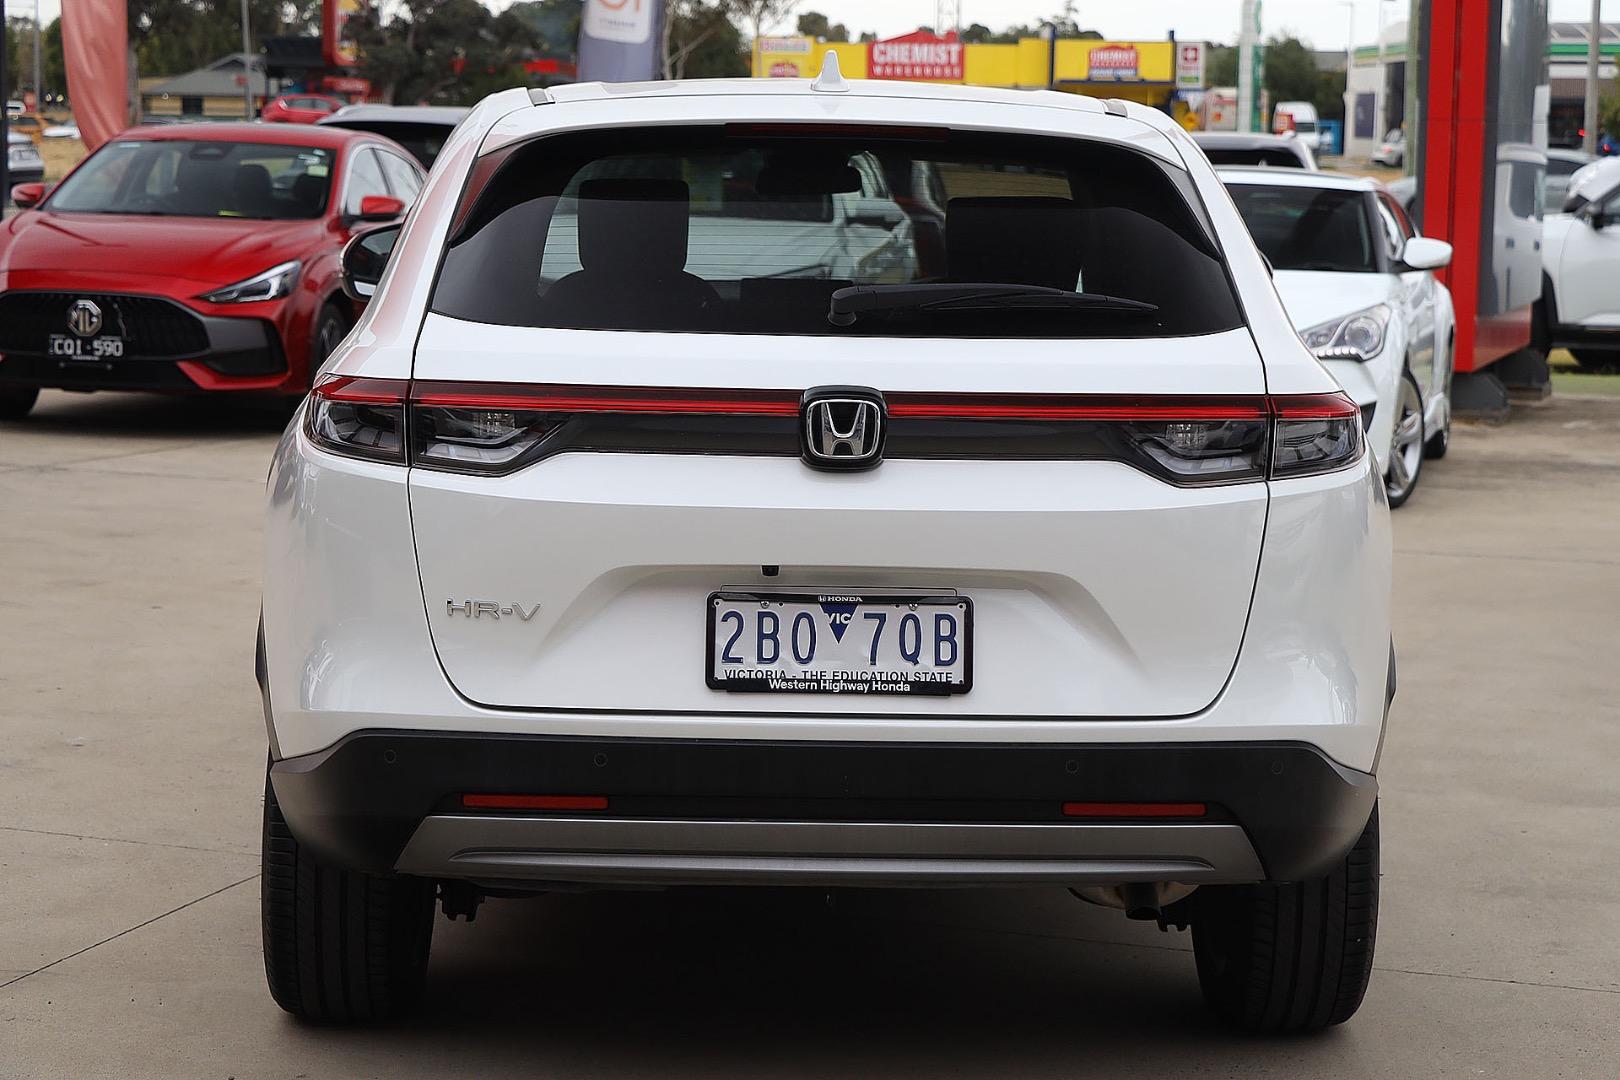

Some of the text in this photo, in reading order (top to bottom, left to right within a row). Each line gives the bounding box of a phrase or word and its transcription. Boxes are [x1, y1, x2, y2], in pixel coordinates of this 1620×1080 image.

[873, 42, 961, 64] CHEMIST
[446, 598, 541, 621] HR-V
[825, 613, 851, 624] VIC
[863, 612, 958, 667] 7QB
[724, 669, 787, 679] VICTORIA
[801, 670, 827, 680] THE
[832, 671, 909, 681] EDUCATION
[913, 672, 953, 682] STATE
[768, 678, 911, 694] Western Highway Honda
